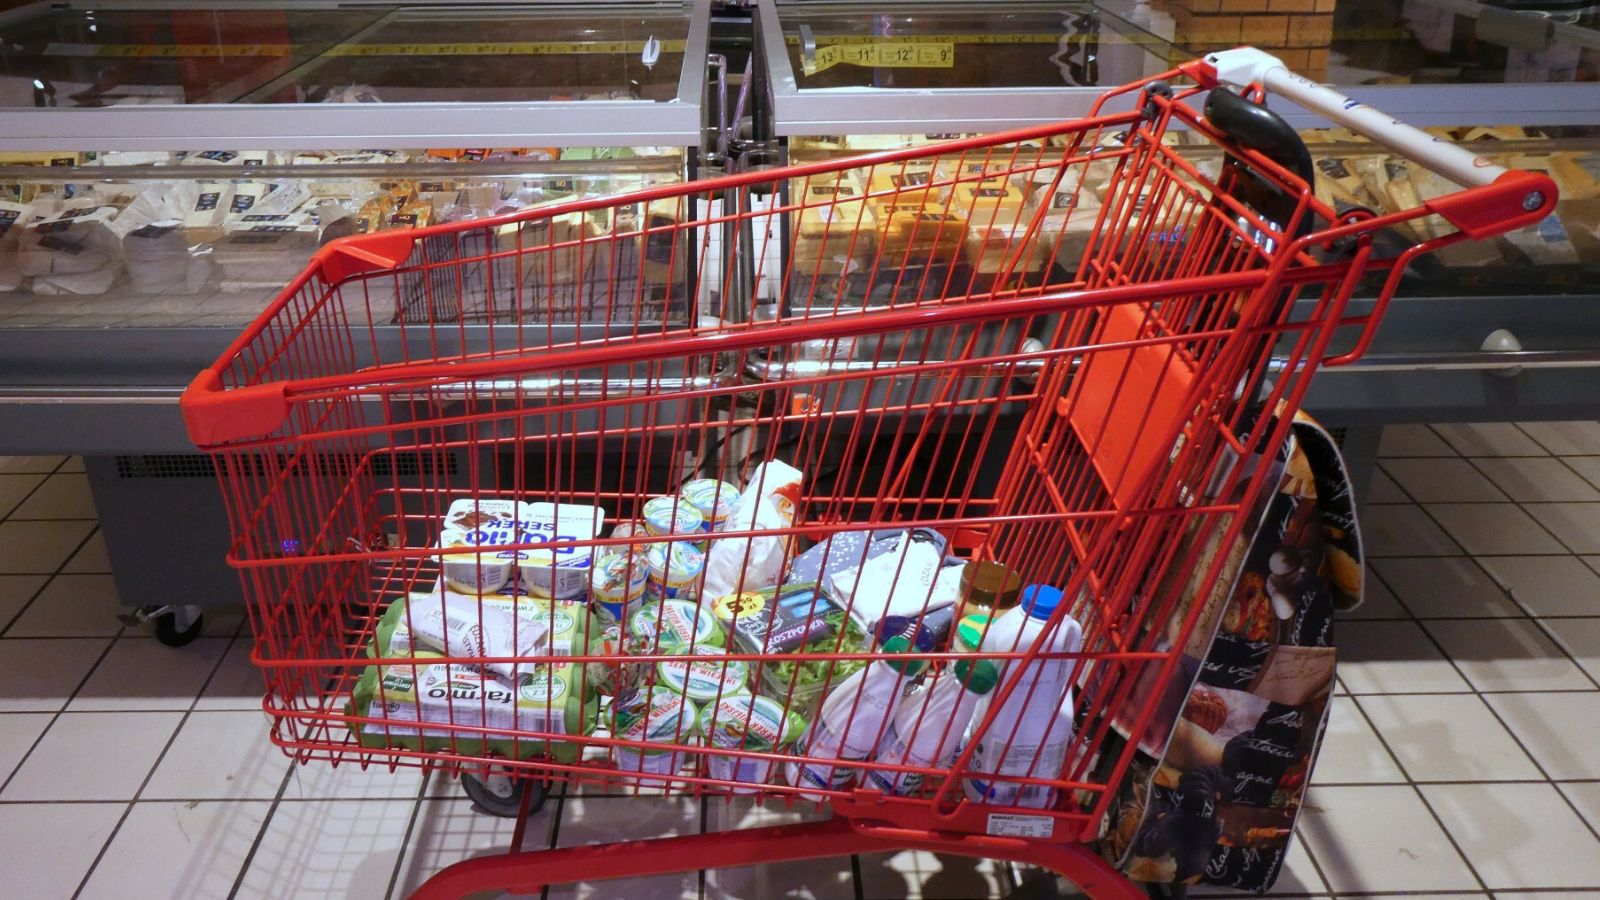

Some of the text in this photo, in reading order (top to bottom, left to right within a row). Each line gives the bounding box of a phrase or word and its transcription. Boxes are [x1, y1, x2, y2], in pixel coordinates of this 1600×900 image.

[487, 519, 555, 532] SEREK
[767, 618, 825, 653] ROSZPOKA
[668, 661, 737, 685] SERK WIEJKI
[428, 688, 513, 704] farmio
[372, 701, 401, 710] famio
